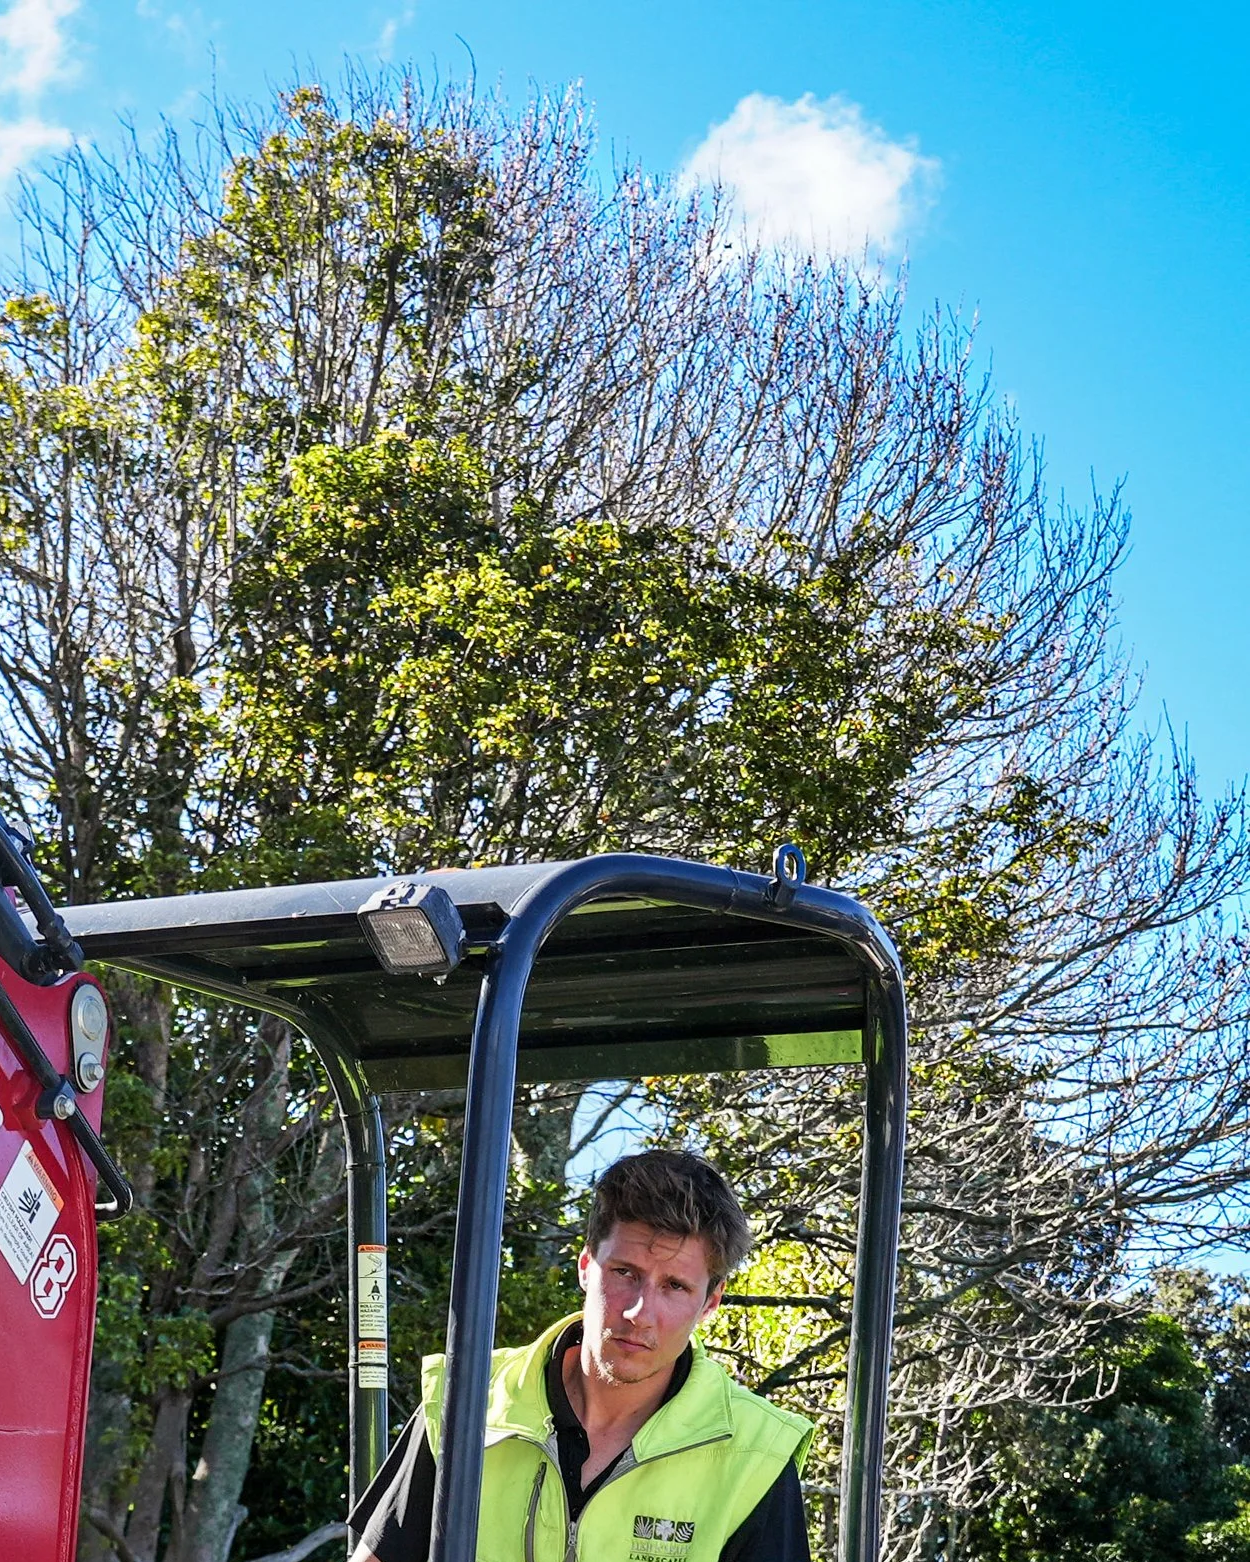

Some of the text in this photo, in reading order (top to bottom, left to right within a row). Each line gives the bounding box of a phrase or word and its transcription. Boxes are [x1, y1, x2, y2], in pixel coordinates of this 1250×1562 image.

[31, 1158, 58, 1201] WARNING
[1, 1191, 15, 1214] CRUSH
[30, 1234, 77, 1319] 8
